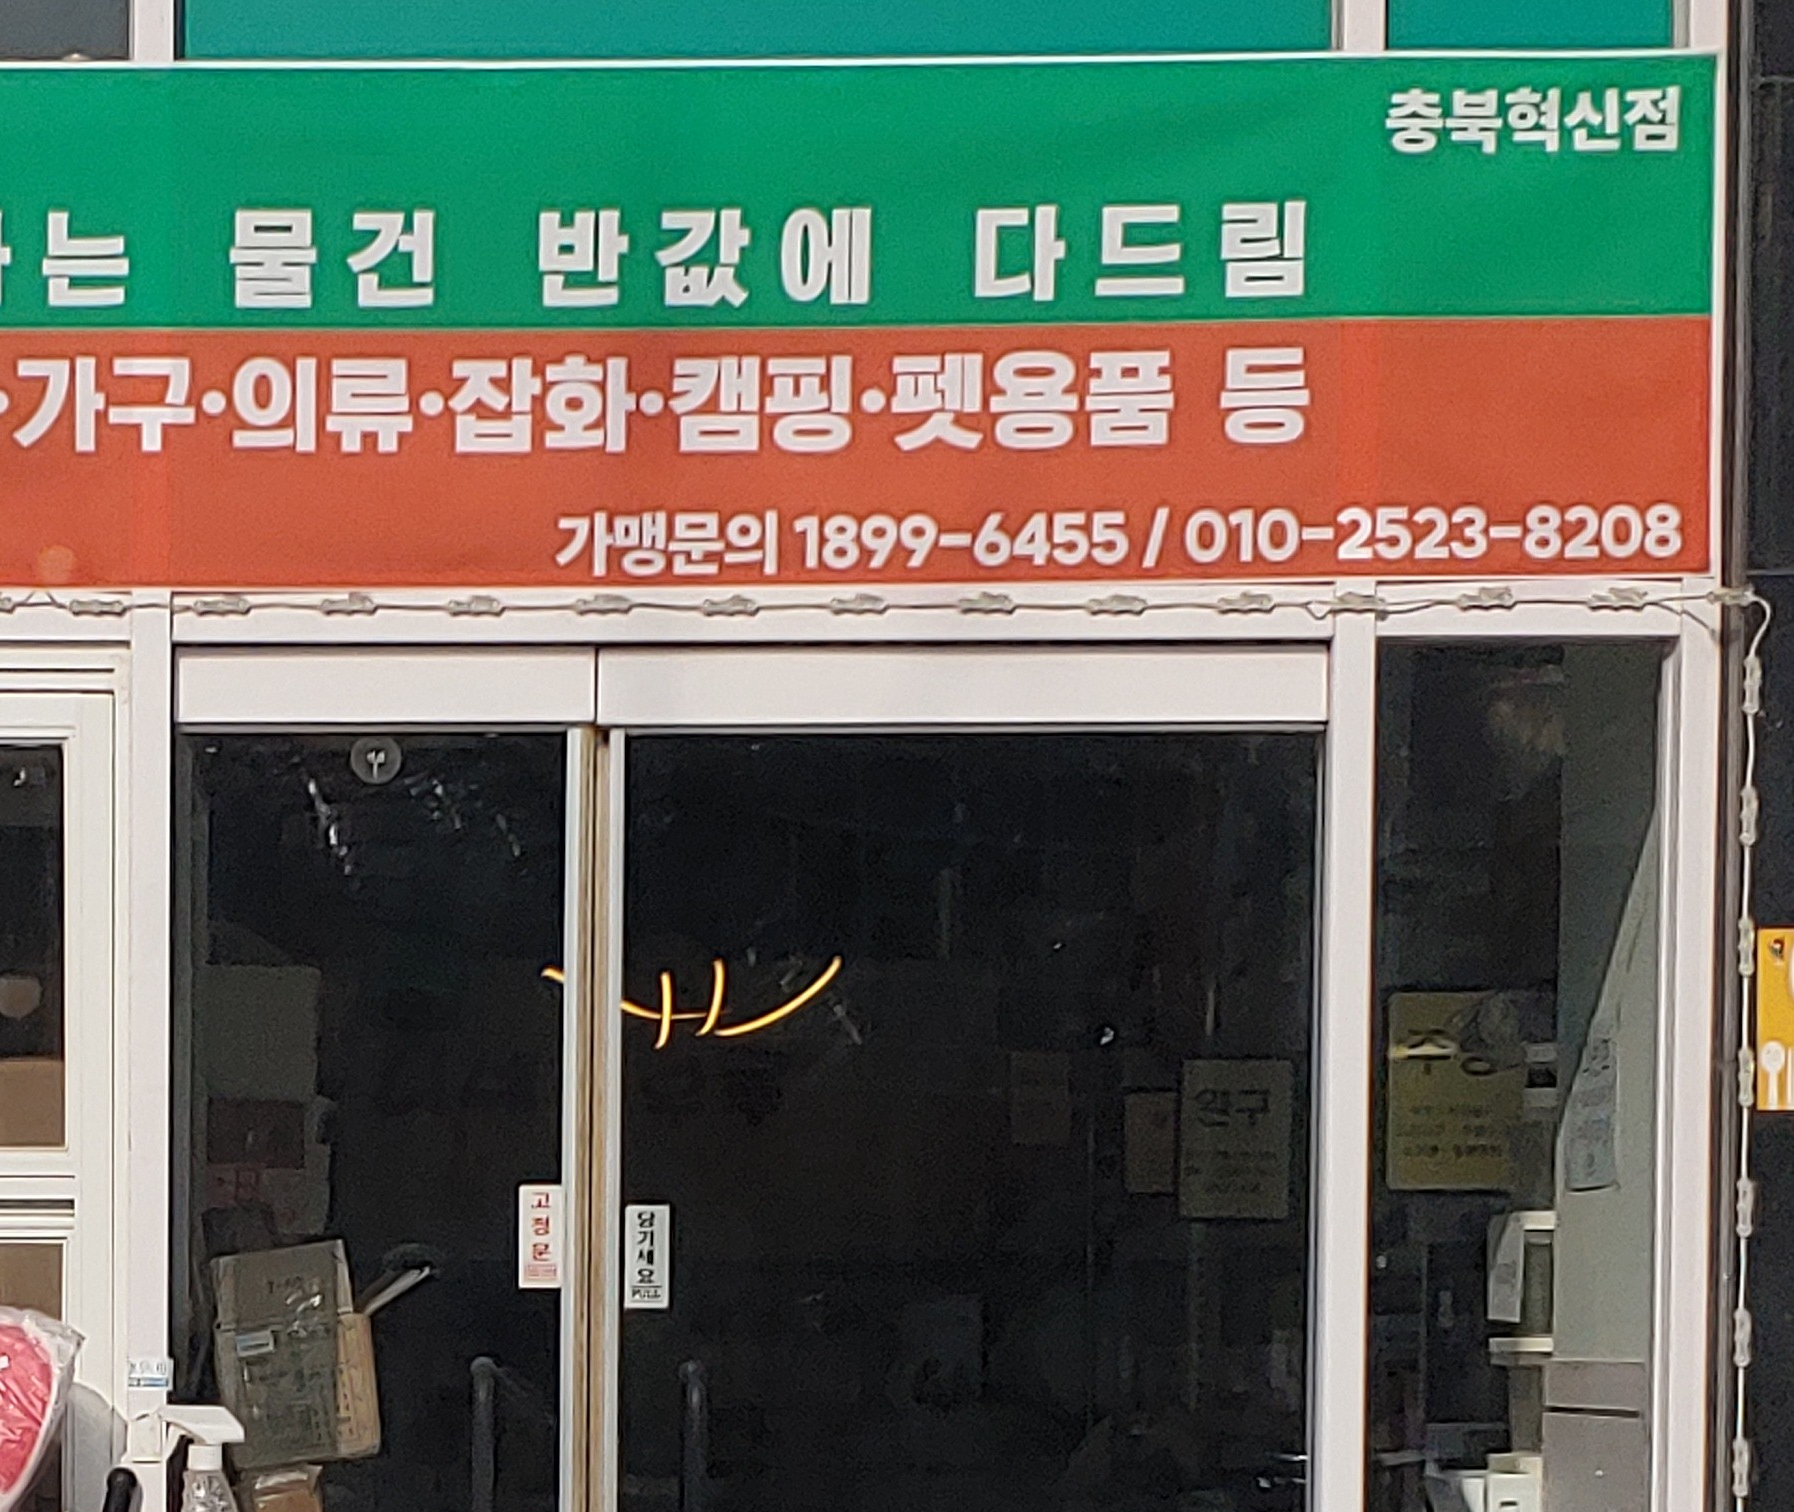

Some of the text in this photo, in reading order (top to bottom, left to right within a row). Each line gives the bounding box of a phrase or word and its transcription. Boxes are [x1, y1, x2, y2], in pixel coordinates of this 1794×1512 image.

[1385, 85, 1681, 154] 충북혁신점
[229, 209, 436, 308] 물건
[537, 207, 873, 307] 반값에
[972, 200, 1307, 302] 다드림
[1219, 345, 1311, 444] 등
[555, 509, 779, 577] 가맹문의
[793, 509, 1130, 570] 1899-6455
[1183, 505, 1684, 563] 010-2523-8208
[530, 1191, 552, 1262] 고정문
[636, 1210, 656, 1285] 당기세요
